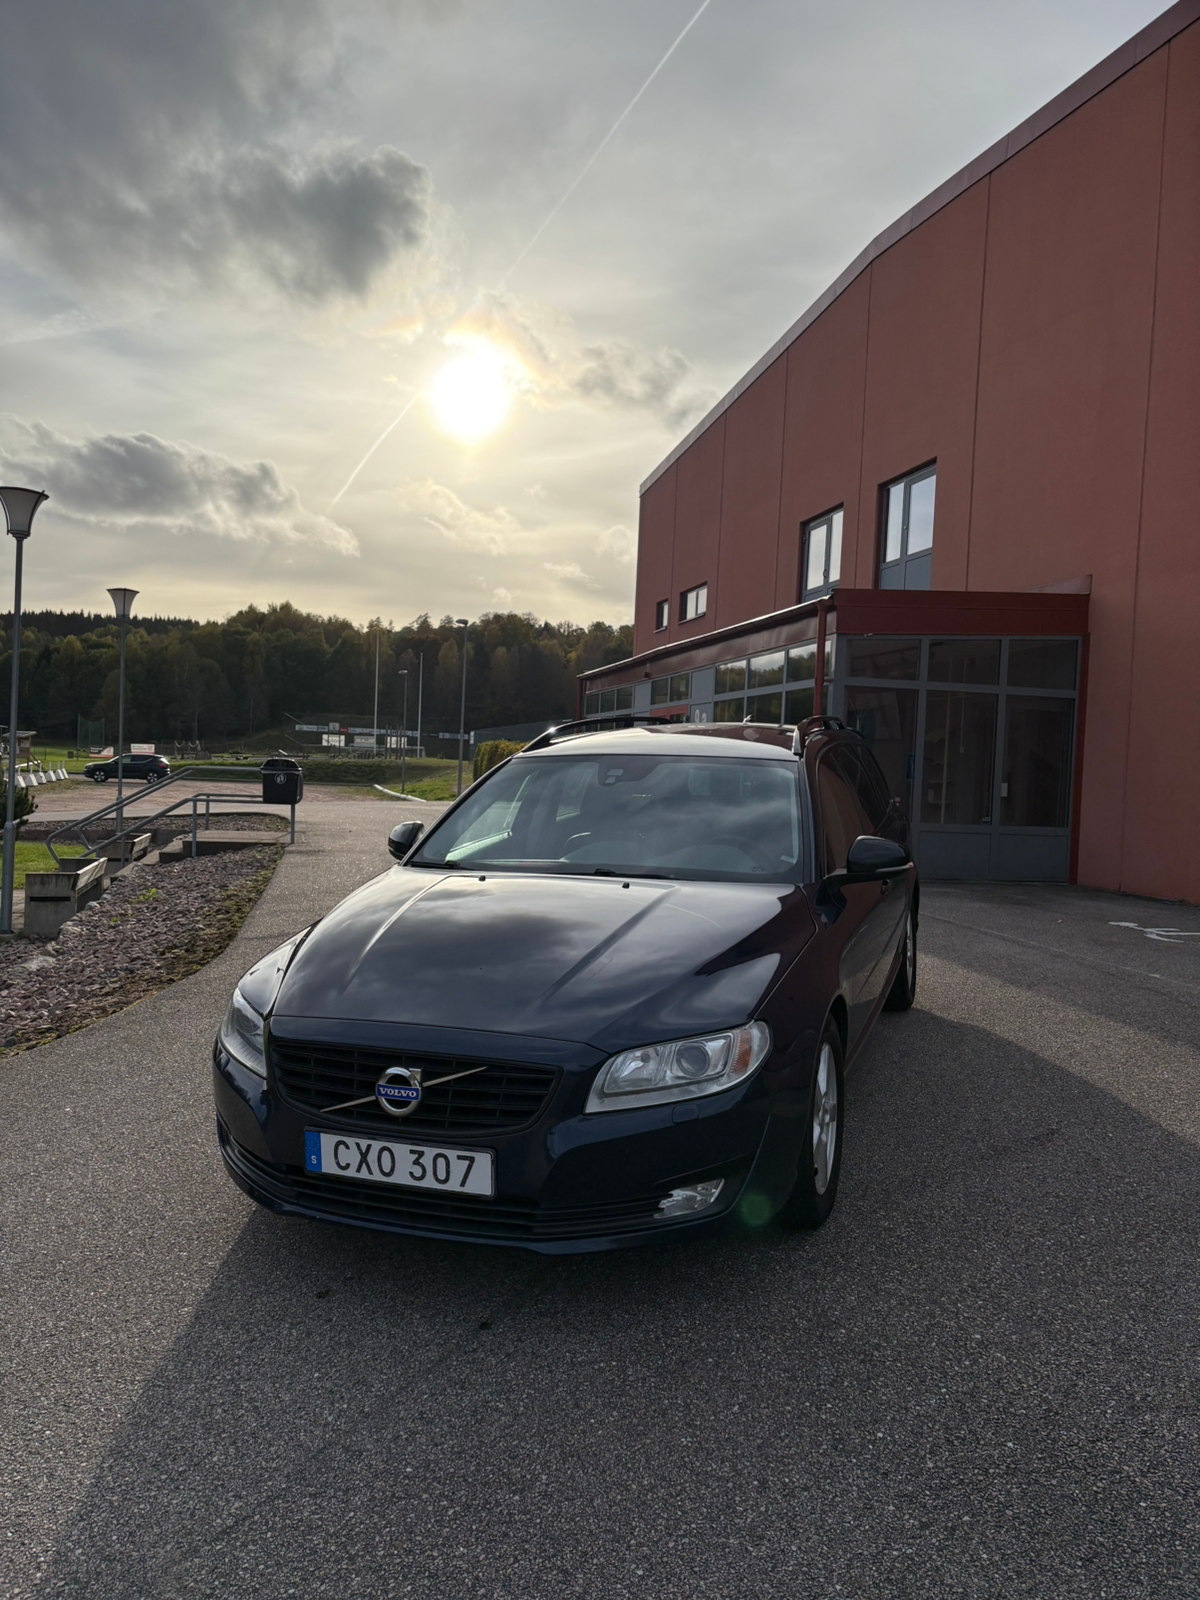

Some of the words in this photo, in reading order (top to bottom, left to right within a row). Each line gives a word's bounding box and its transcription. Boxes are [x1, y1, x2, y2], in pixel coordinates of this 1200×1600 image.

[379, 1087, 417, 1098] VOLVO
[311, 1155, 317, 1164] S
[333, 1140, 396, 1178] CXO
[409, 1149, 475, 1187] 307
